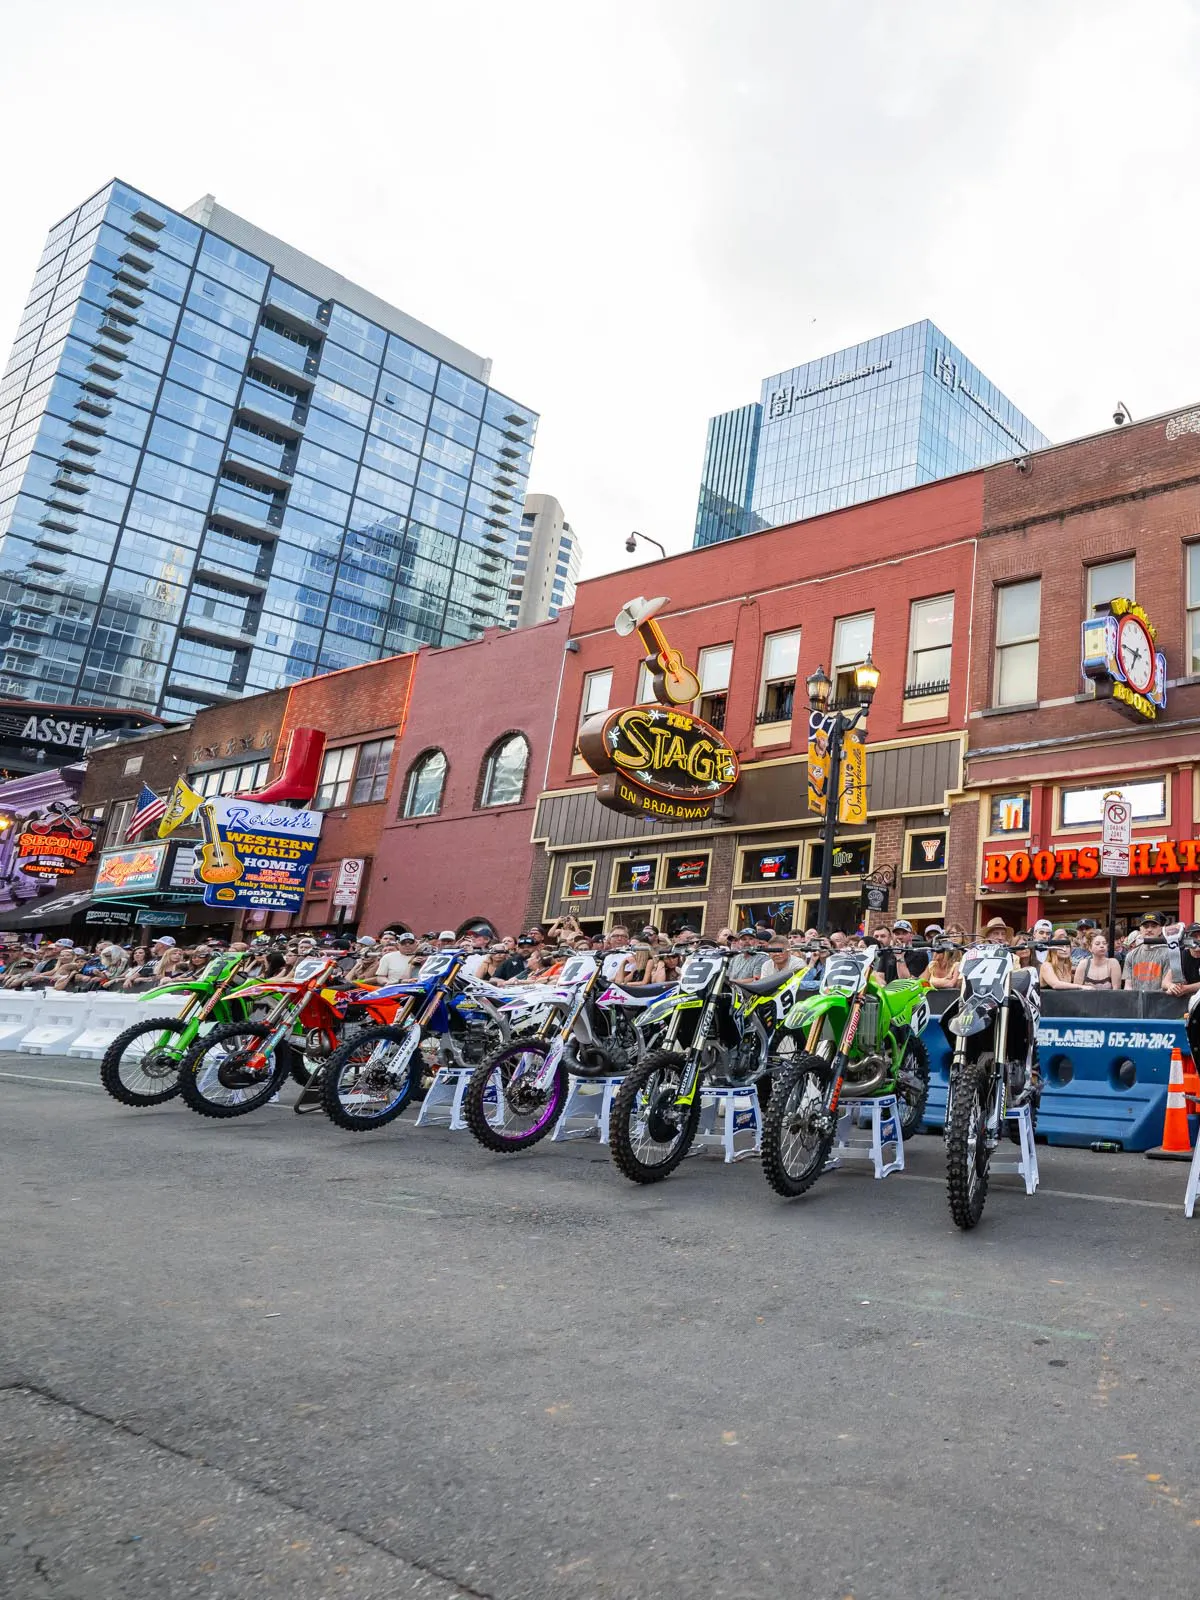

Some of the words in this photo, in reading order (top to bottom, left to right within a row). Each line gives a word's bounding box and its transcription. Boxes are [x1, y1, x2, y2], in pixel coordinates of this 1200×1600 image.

[667, 712, 694, 731] THE
[614, 710, 737, 783] STAGE
[620, 785, 637, 804] ON
[643, 797, 710, 819] BROADWAY
[226, 807, 315, 832] Robert's
[20, 833, 94, 853] SECOND
[226, 831, 316, 851] WESTERN
[20, 845, 89, 863] FIDDLE
[236, 844, 301, 859] WORLD
[40, 860, 65, 868] MUSIC
[243, 857, 297, 872] HOME
[298, 864, 309, 875] of
[984, 846, 1100, 884] BOOTS
[234, 880, 259, 889] Honky
[260, 882, 278, 890] Tonk
[238, 889, 273, 898] Honky
[275, 891, 300, 901] Tonk
[249, 896, 287, 906] GRILL
[294, 961, 324, 980] 5
[421, 955, 451, 975] 22
[681, 961, 714, 985] 9
[825, 959, 862, 986] 2
